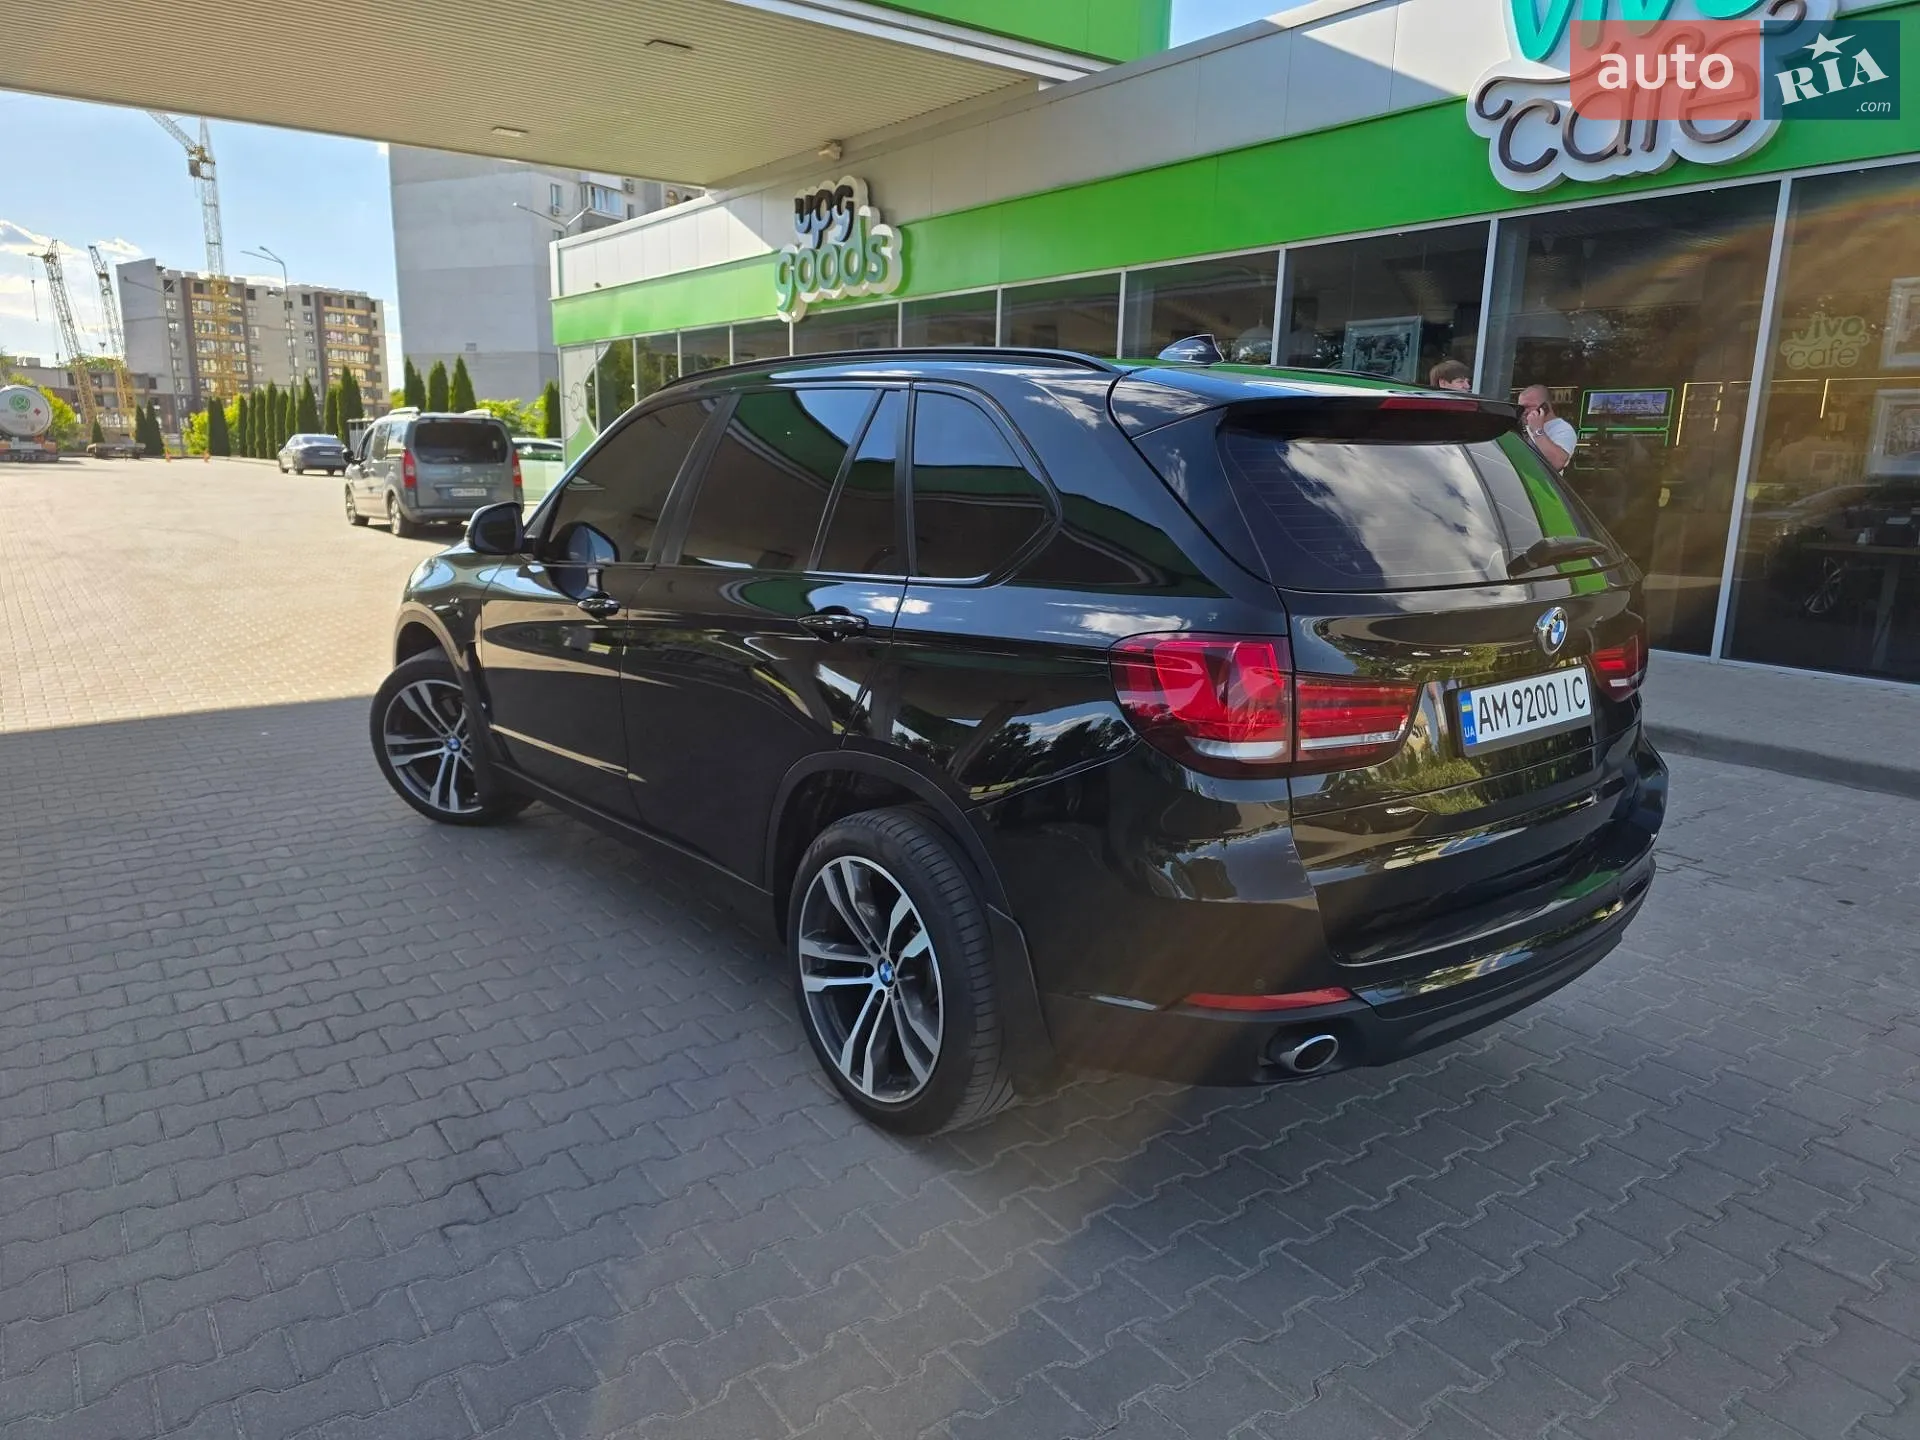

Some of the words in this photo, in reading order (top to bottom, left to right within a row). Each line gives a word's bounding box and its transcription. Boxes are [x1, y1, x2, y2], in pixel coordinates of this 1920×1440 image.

[775, 211, 888, 313] goods
[1793, 314, 1864, 340] vivo
[1563, 676, 1586, 713] IC
[1464, 726, 1476, 738] UA
